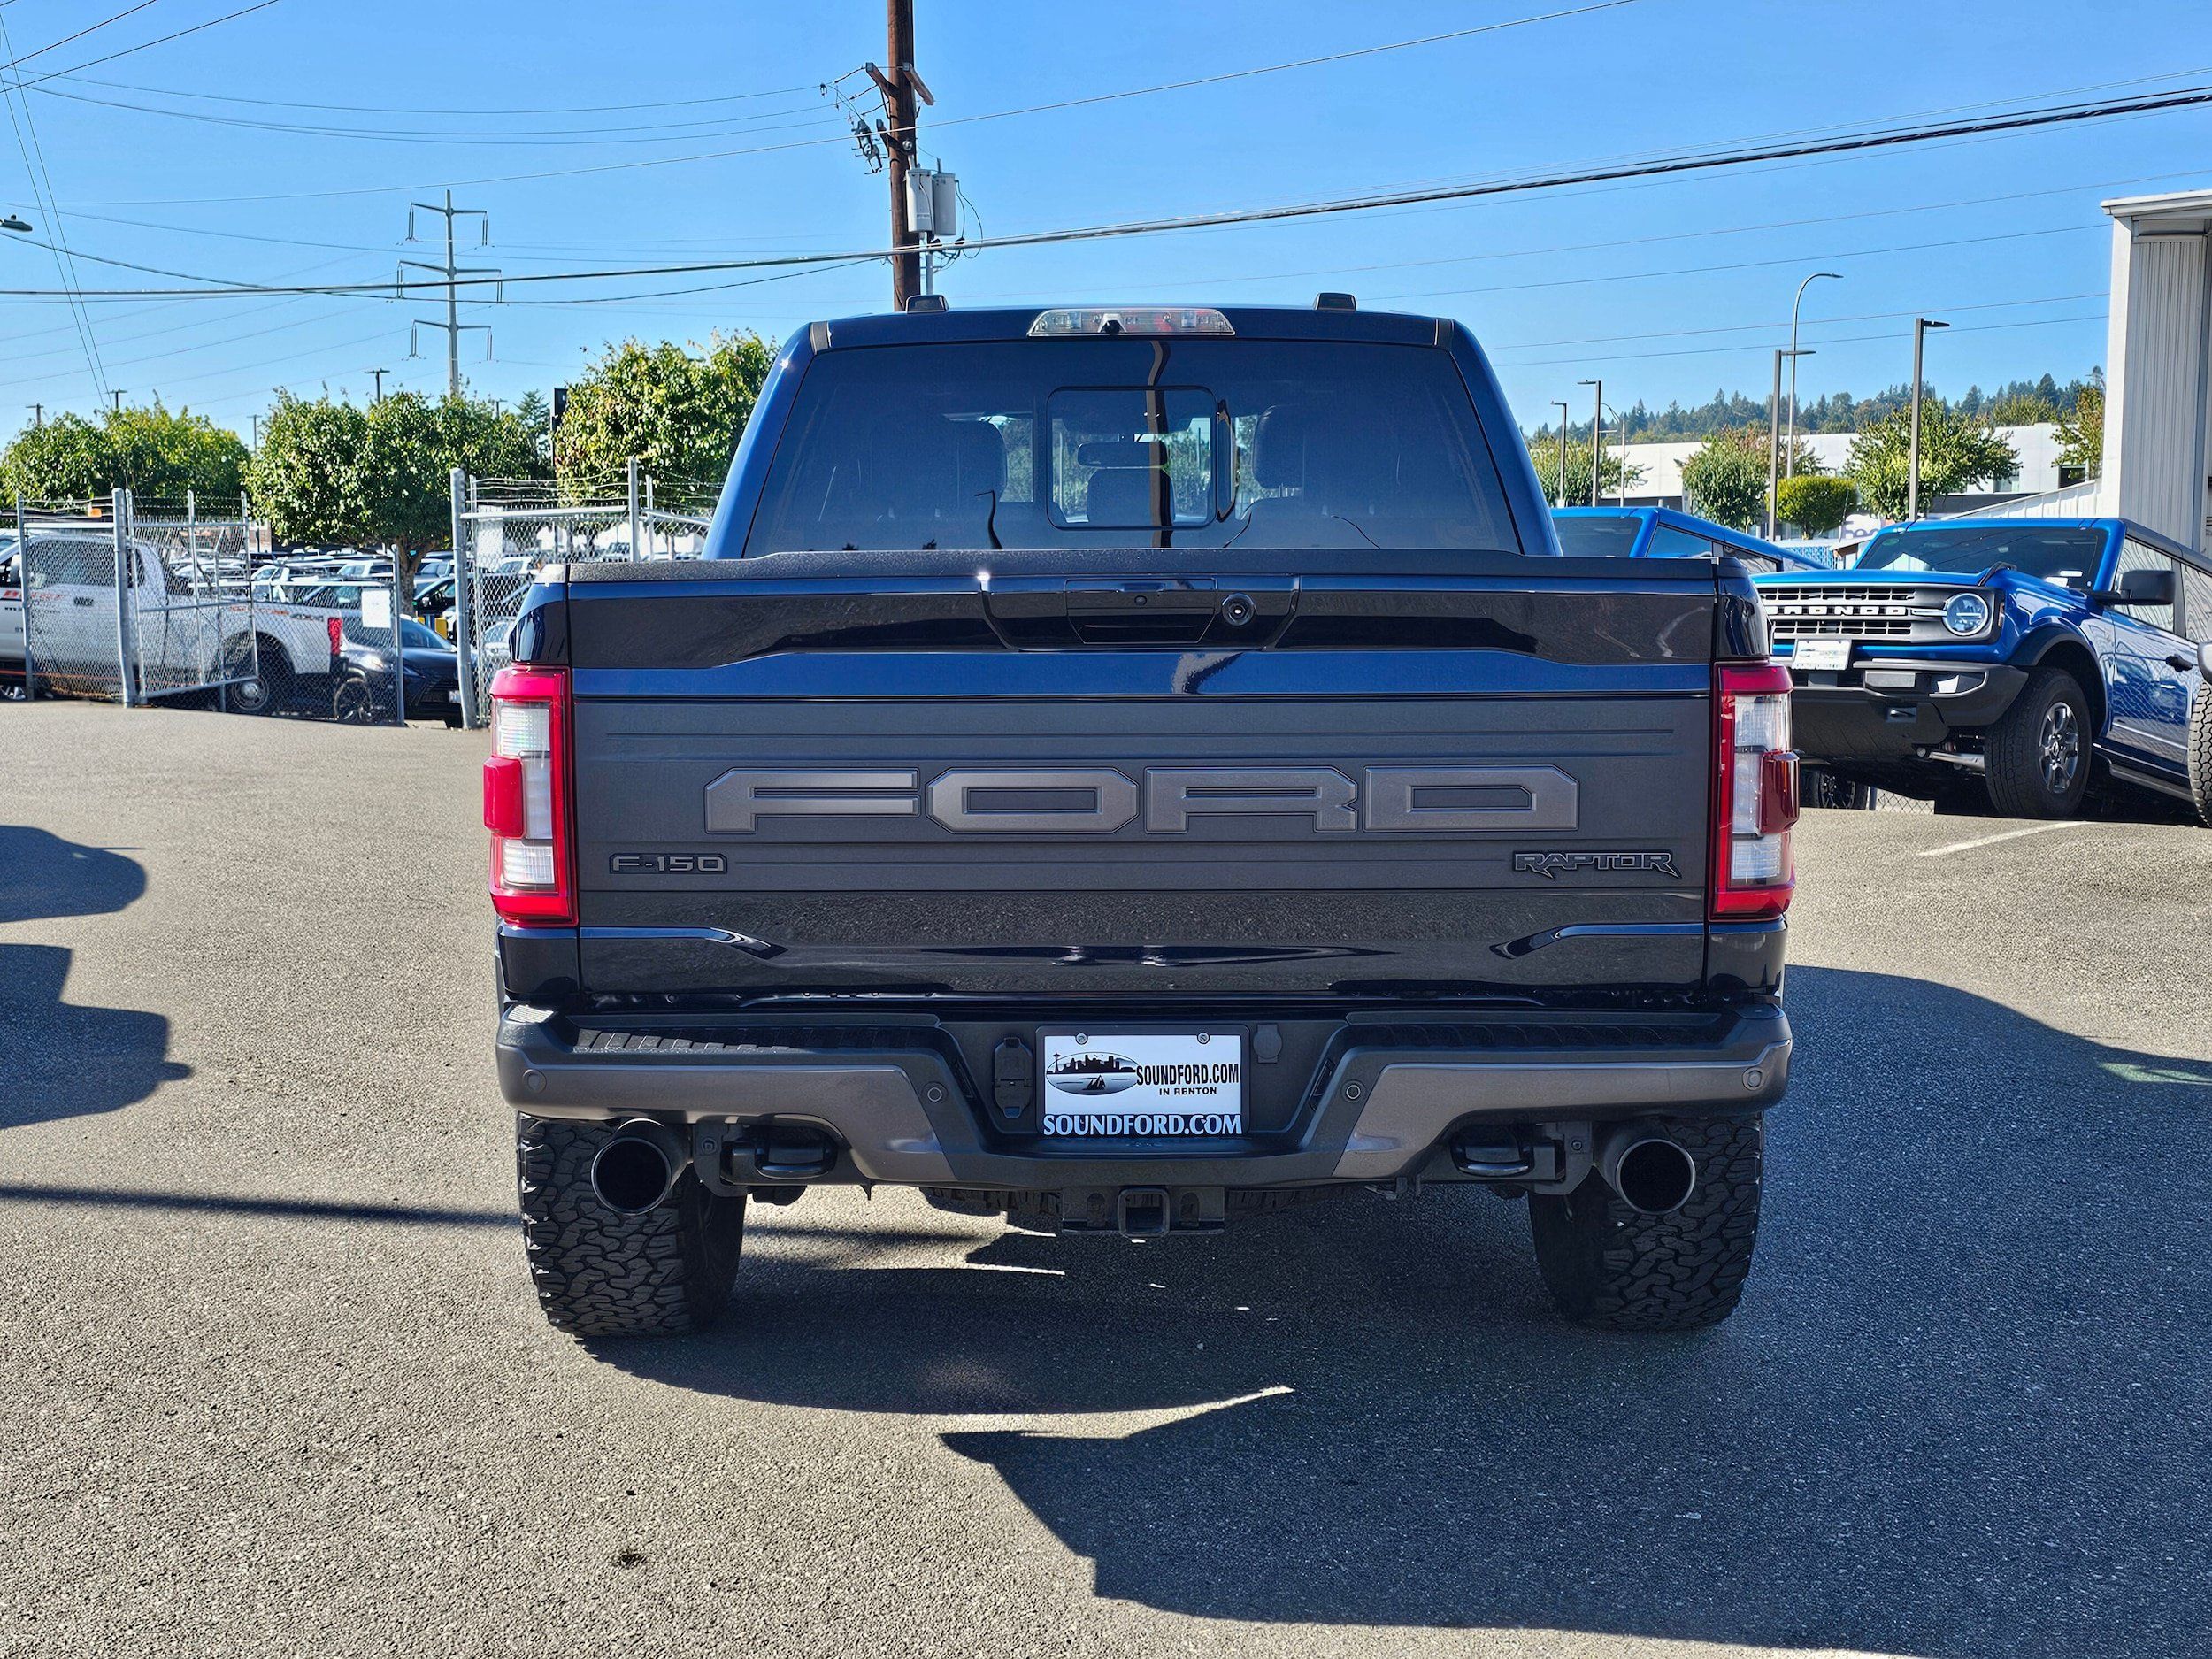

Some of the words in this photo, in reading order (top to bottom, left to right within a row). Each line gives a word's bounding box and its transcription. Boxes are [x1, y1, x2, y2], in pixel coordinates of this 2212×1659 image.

[705, 766, 1579, 834] FORD
[611, 854, 726, 873] F-150
[1514, 852, 1680, 879] RAPTOR
[1136, 1064, 1239, 1086] SOUNDFORD.COM
[1159, 1087, 1170, 1096] IN
[1174, 1087, 1217, 1095] RENTON
[1043, 1114, 1242, 1136] SOUNDFORD.COM
